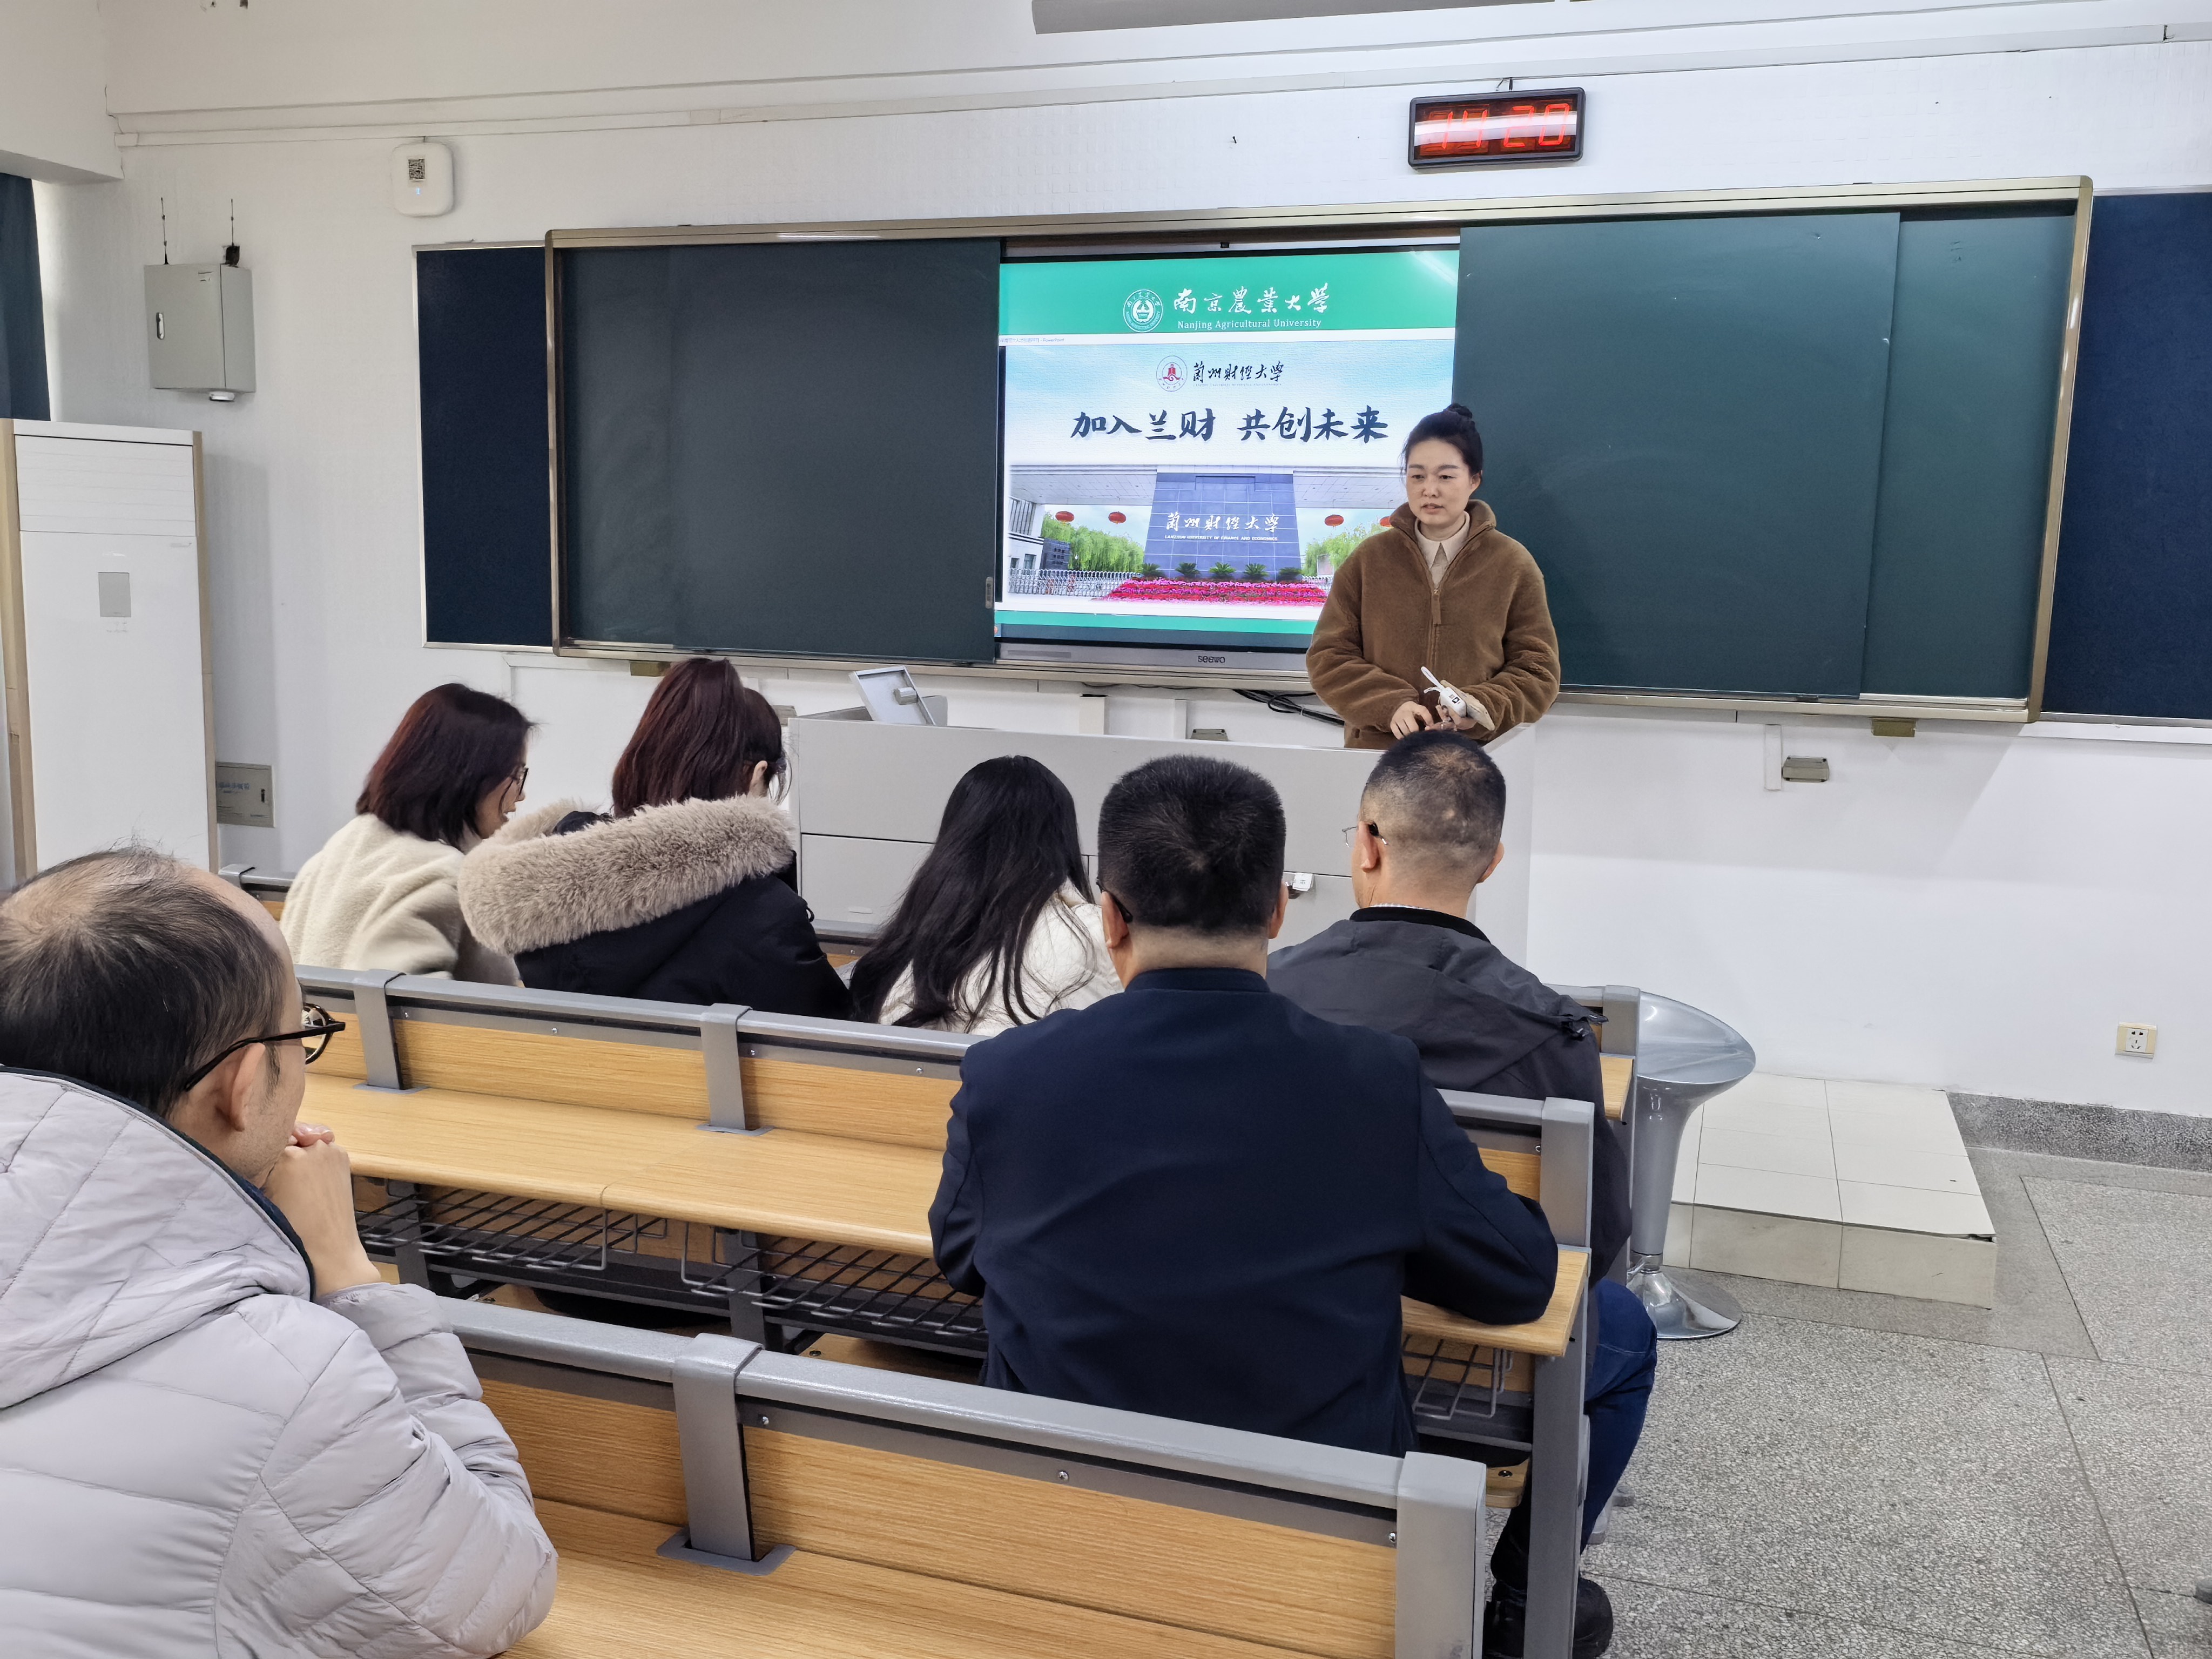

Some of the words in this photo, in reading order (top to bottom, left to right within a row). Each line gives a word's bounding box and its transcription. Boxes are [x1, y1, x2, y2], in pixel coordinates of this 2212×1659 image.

[1177, 320, 1212, 330] Nanjing
[1215, 320, 1270, 330] Agricultural
[1273, 319, 1322, 328] University
[1069, 408, 1216, 442] 加入兰财
[1237, 404, 1389, 444] 共创未来
[1197, 656, 1226, 664] seewo
